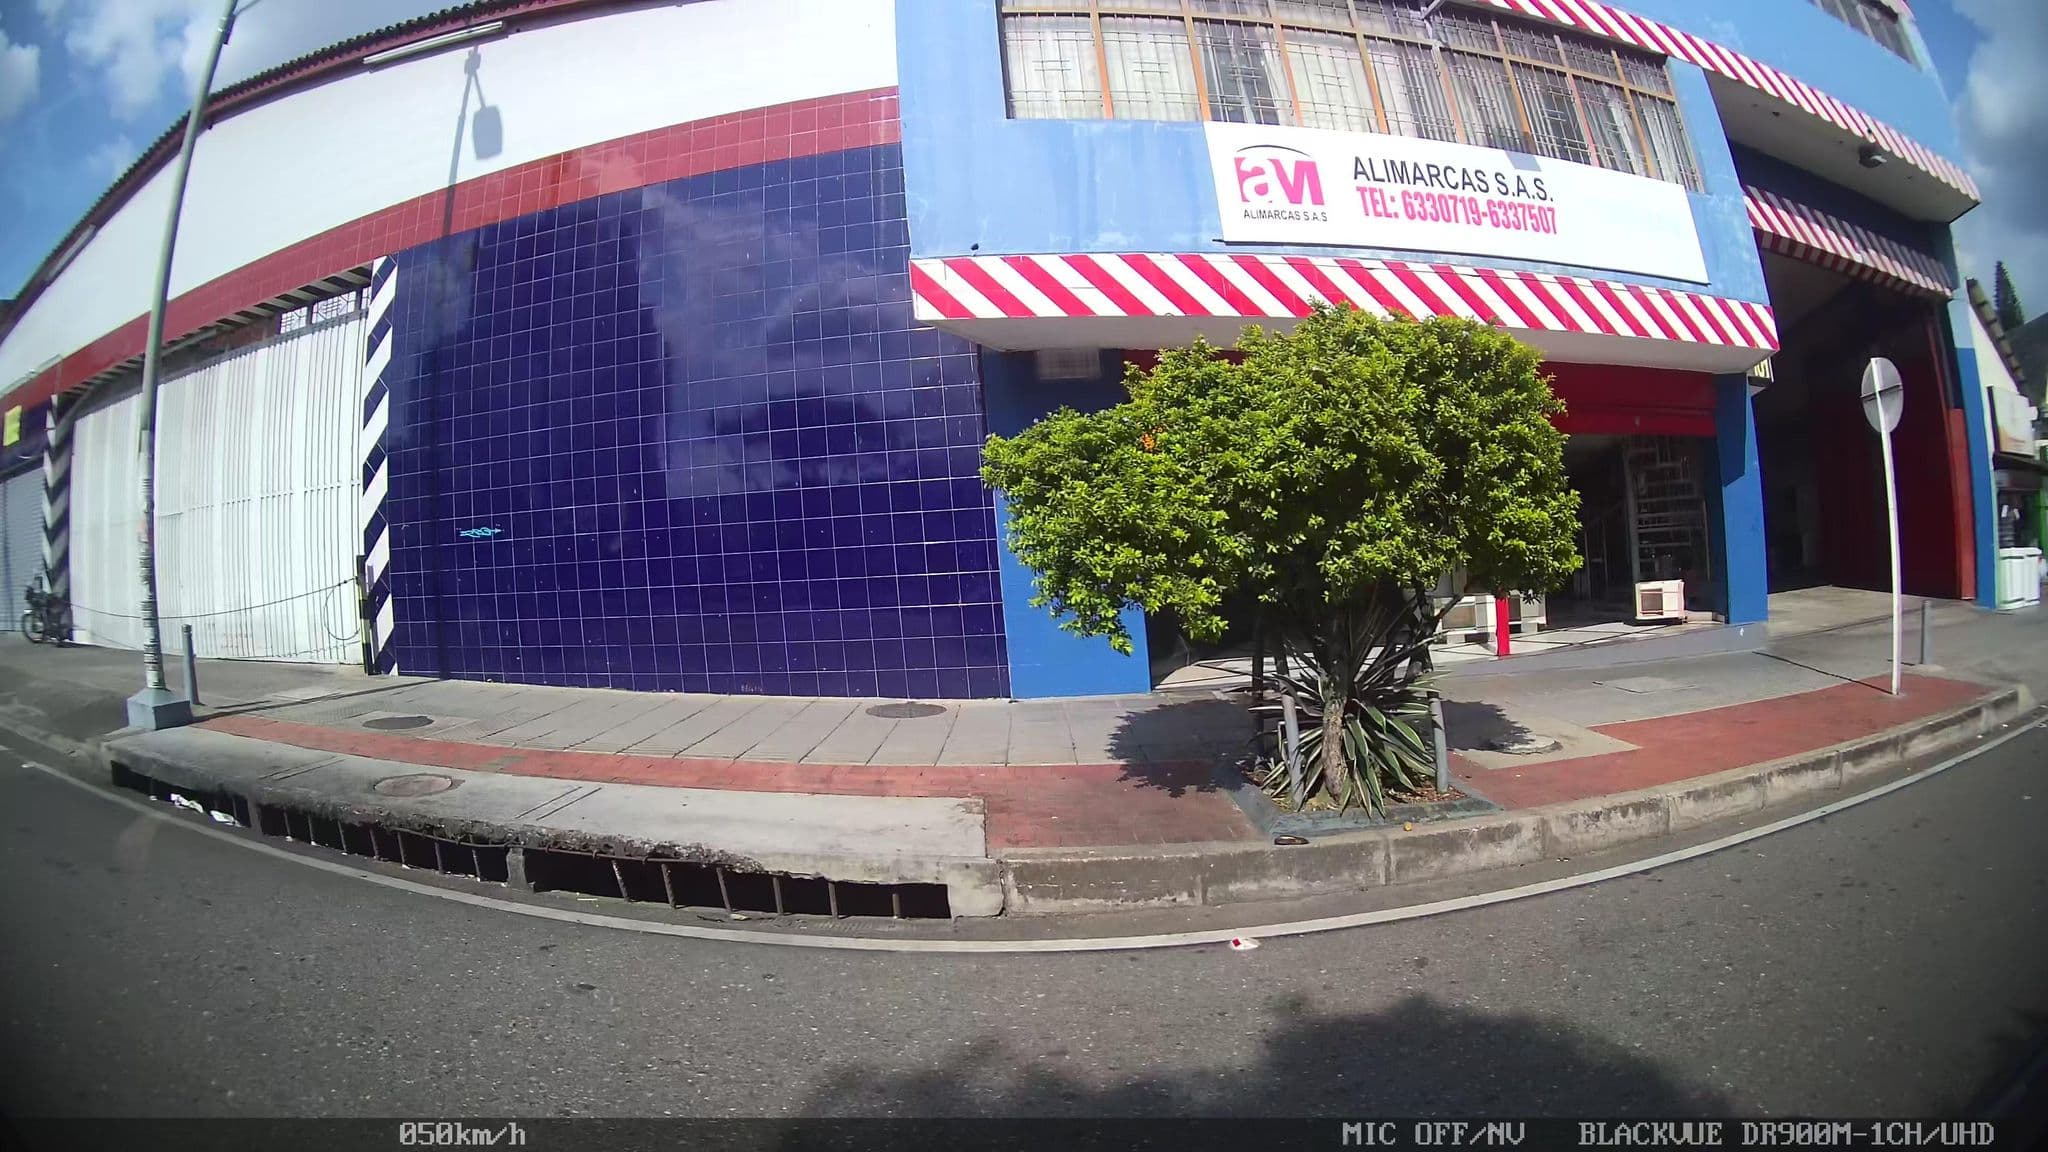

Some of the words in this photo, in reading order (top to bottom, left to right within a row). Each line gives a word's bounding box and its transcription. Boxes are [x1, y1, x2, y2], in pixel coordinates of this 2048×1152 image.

[1353, 156, 1490, 194] ALIMARCAS
[1494, 171, 1555, 202] S.A.S.
[1243, 208, 1301, 221] ALIMARCAS
[1355, 186, 1399, 219] TEL:
[1400, 189, 1557, 235] 6330719-6337507
